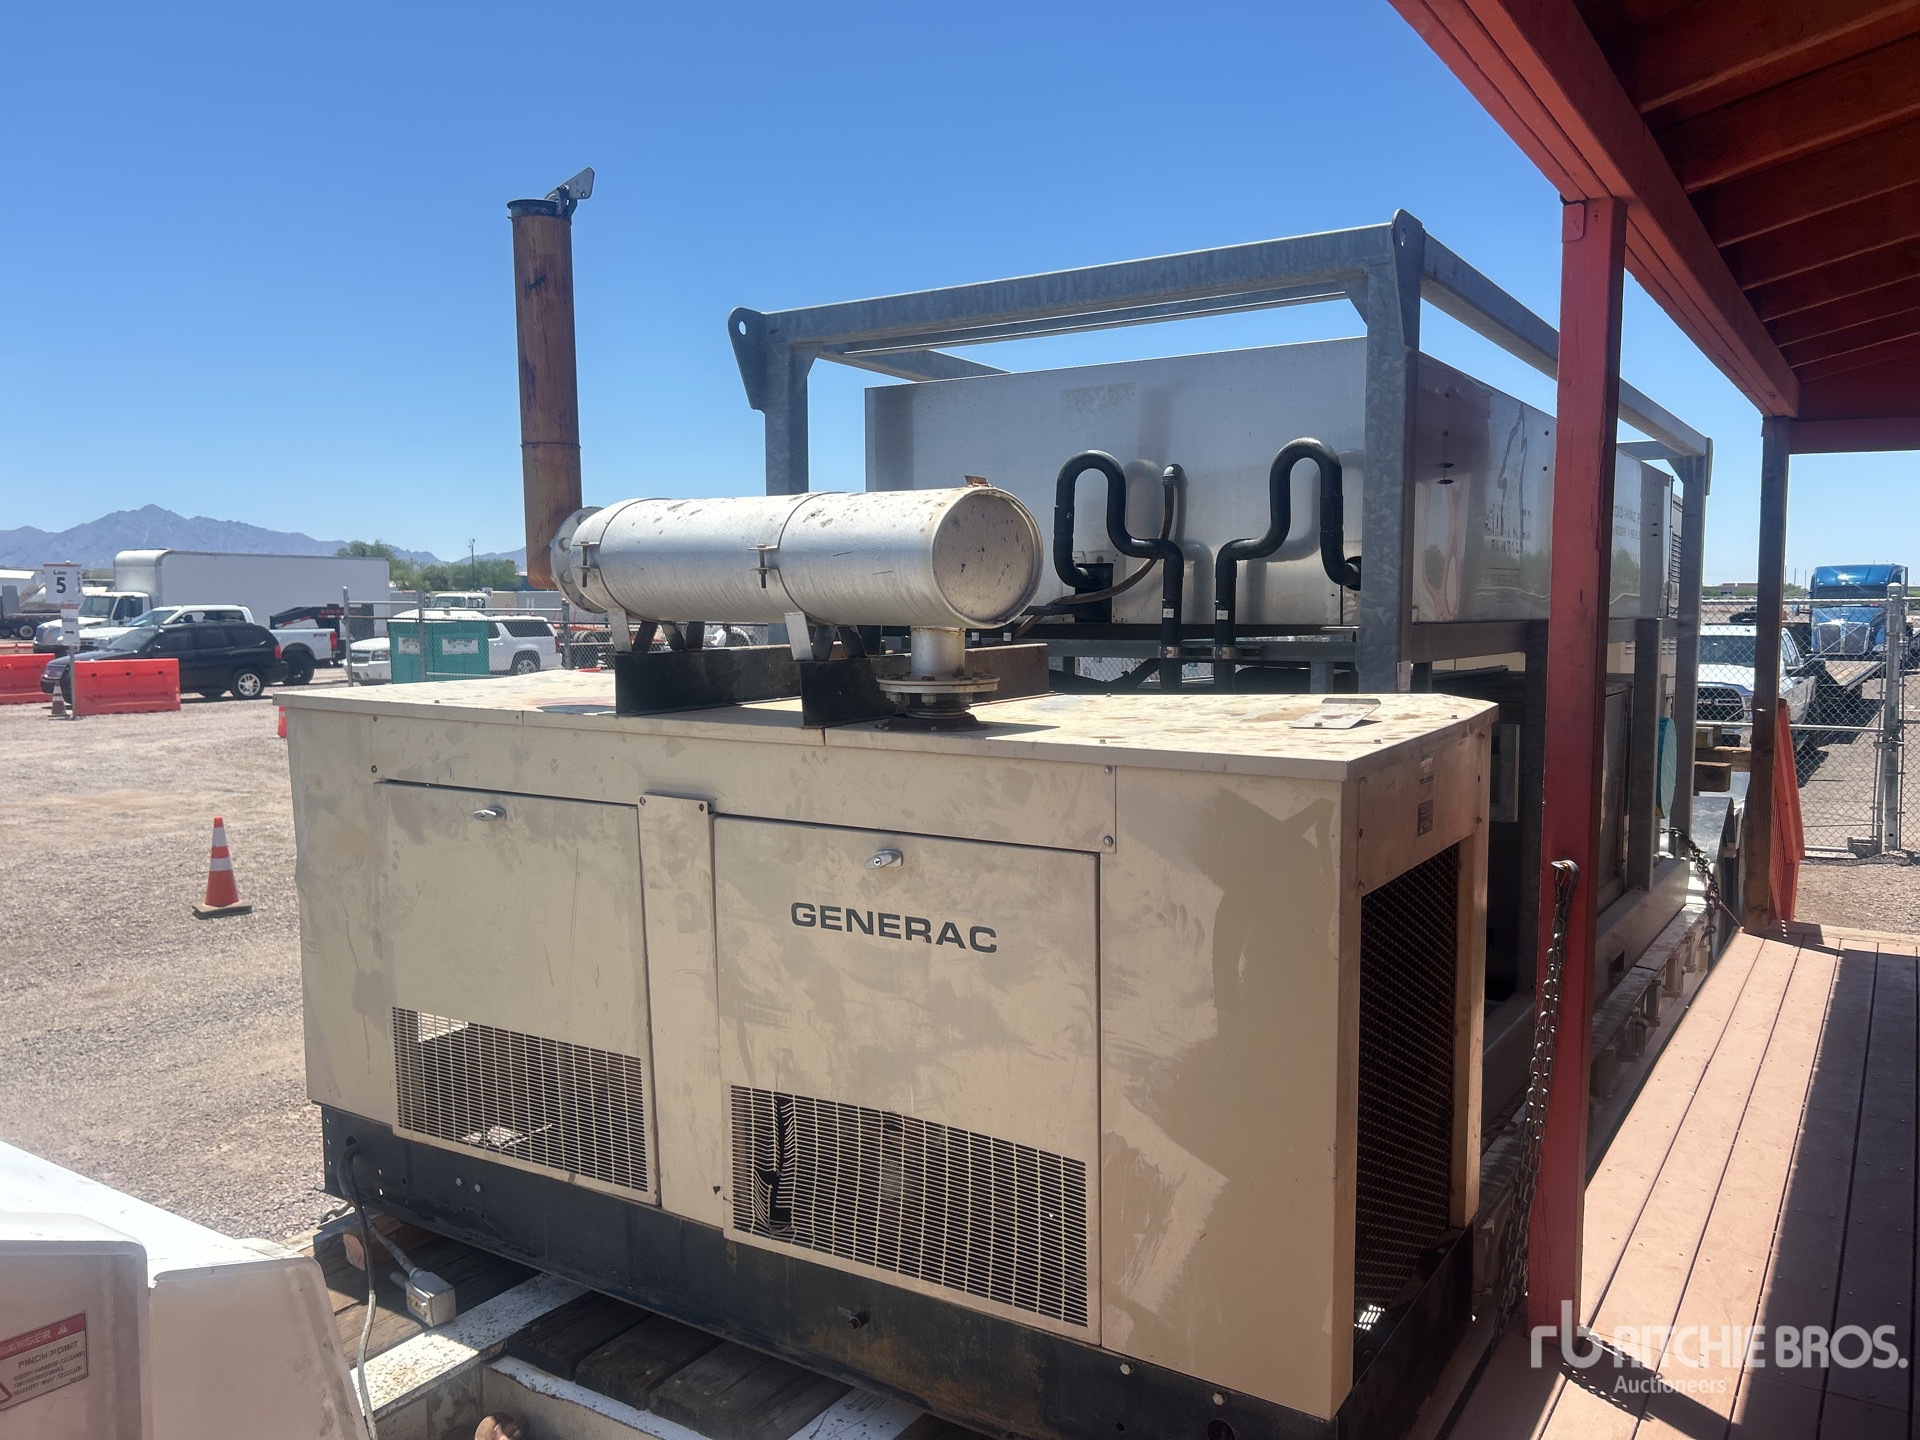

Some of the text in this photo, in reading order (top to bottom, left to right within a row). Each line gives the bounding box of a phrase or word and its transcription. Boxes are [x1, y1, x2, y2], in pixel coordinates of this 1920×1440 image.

[56, 576, 67, 594] 5
[790, 902, 998, 953] GENERAC
[0, 1329, 51, 1356] DANGER
[18, 1340, 79, 1369] PINCH POINT
